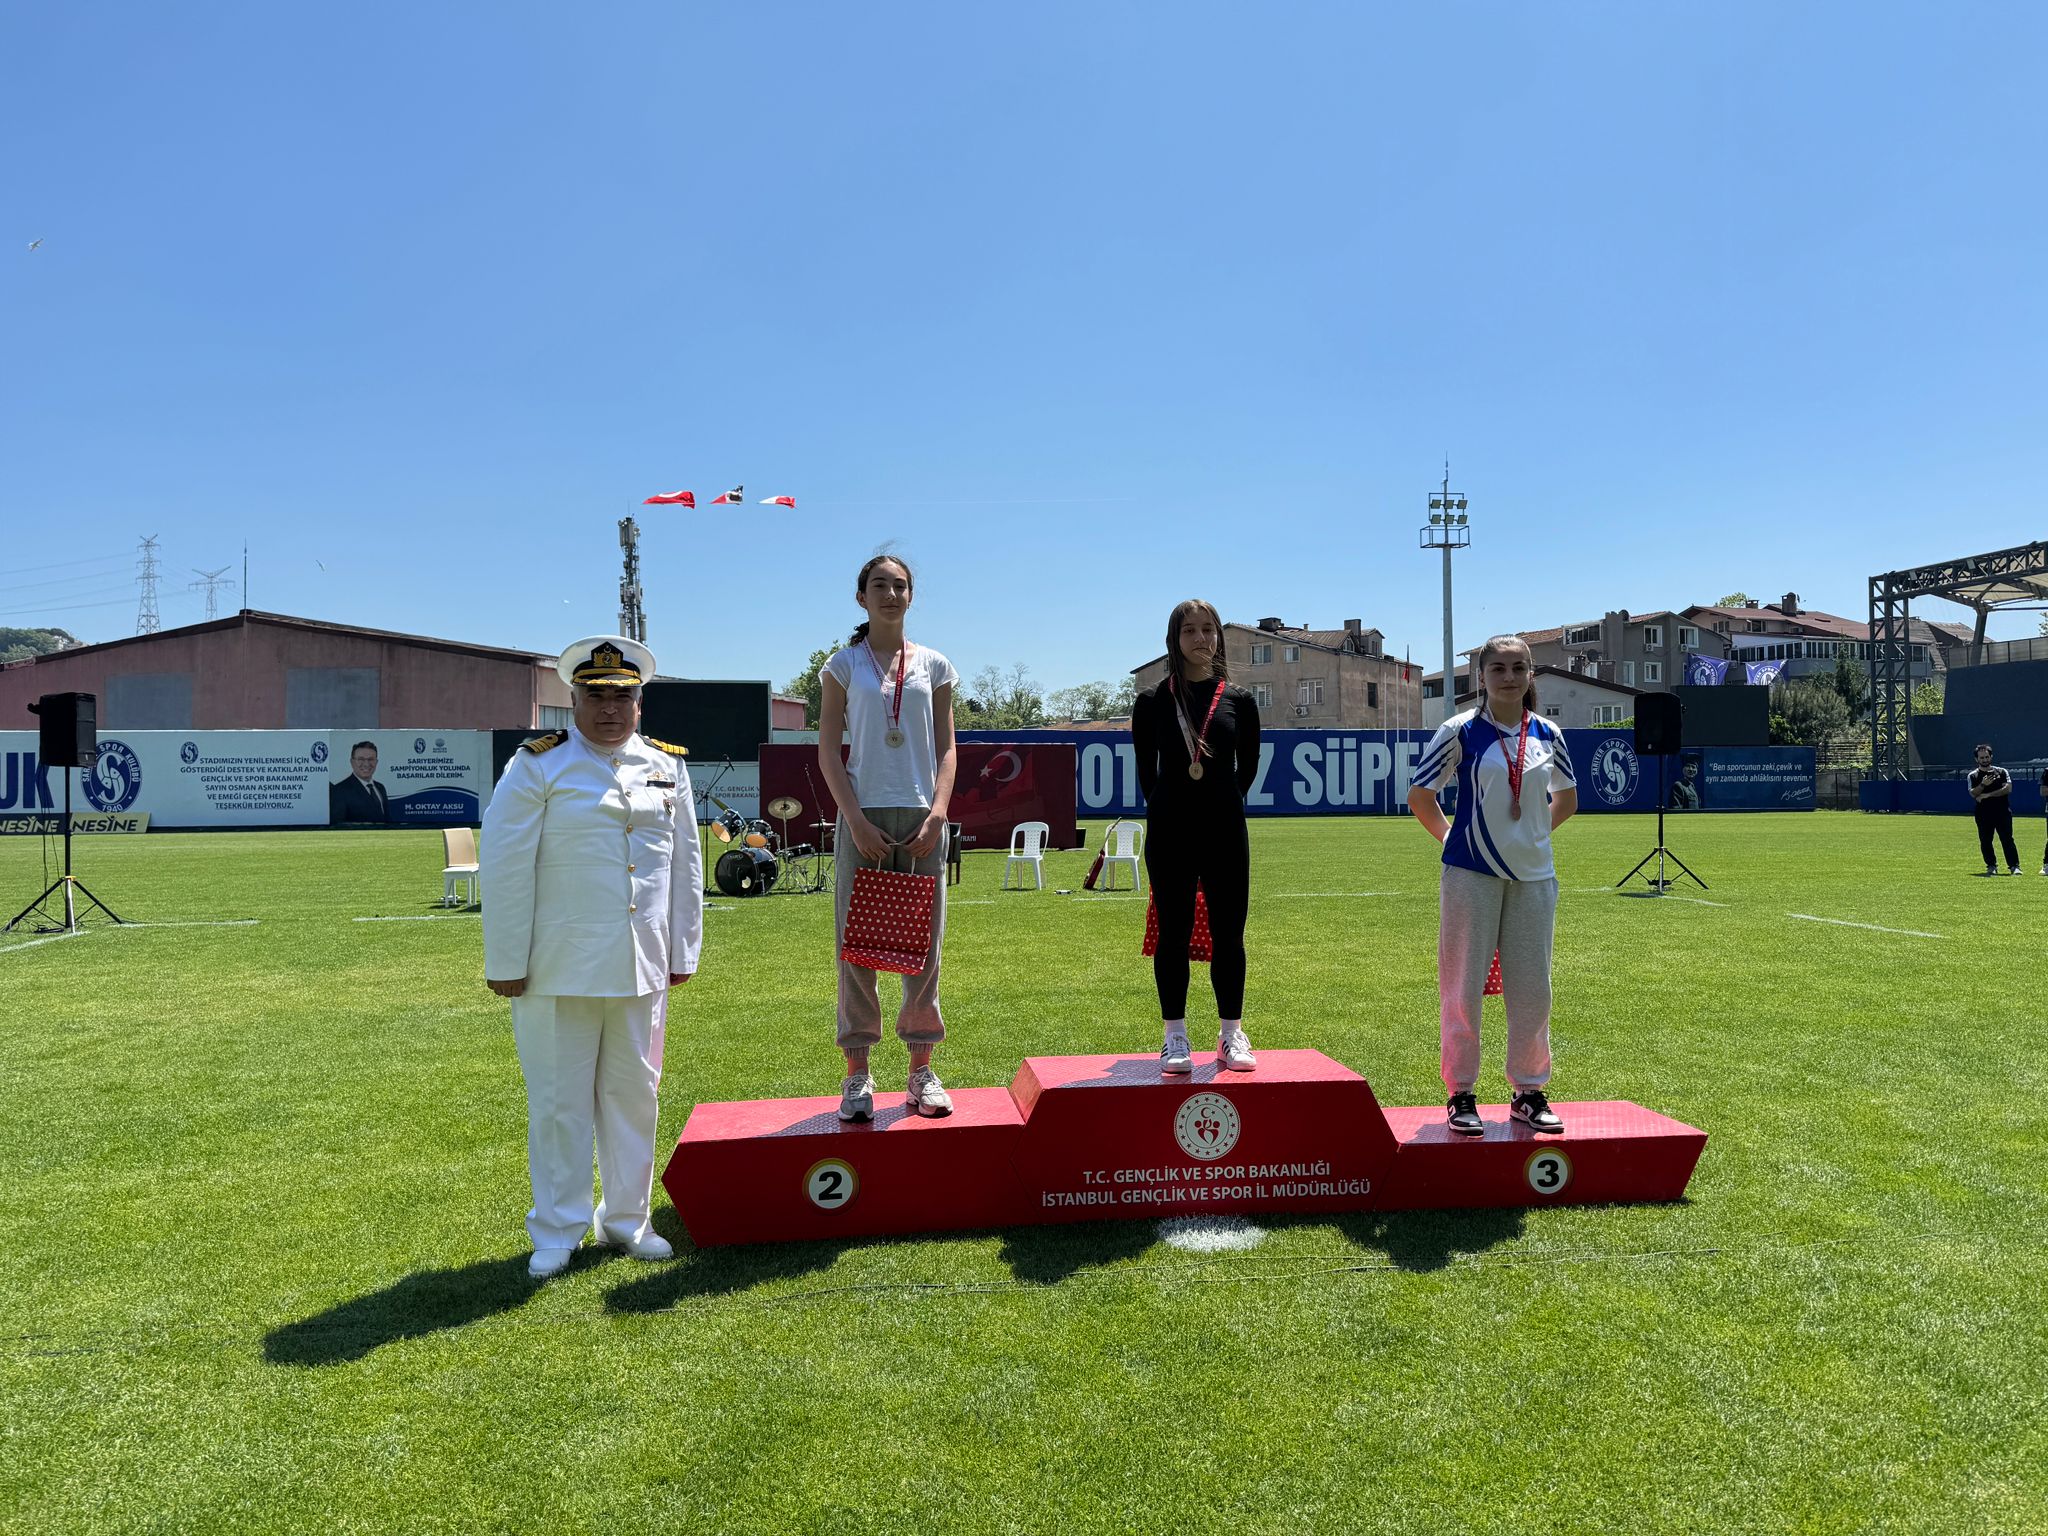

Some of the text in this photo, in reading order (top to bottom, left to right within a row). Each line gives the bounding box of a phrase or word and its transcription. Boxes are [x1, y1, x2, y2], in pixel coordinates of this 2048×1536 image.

[100, 743, 124, 754] SPOR
[244, 756, 293, 764] YENİLENMESİ
[294, 757, 309, 765] İÇİN
[180, 765, 226, 773] GÖSTERDİĞİ
[390, 764, 438, 772] ŞAMPİYONLUK
[1727, 764, 1761, 772] sporcunun
[200, 775, 232, 784] GENÇLİK
[1720, 774, 1749, 782] zamanda
[257, 784, 281, 793] AŞKIN
[218, 792, 242, 800] EMEĞİ
[243, 793, 268, 801] GEÇEN
[1608, 795, 1625, 803] 1940
[215, 801, 294, 810] TEŞEKKÜR EDİYORUZ.
[1083, 1159, 1331, 1186] T.C. GENÇLİK VE SPOR BAKANLIĞI
[1536, 1159, 1560, 1187] 3
[817, 1170, 844, 1201] 2
[1042, 1179, 1372, 1207] İSTANBUL GENÇLİK VE SPOR İL MÜDÜRLÜĞÜ
